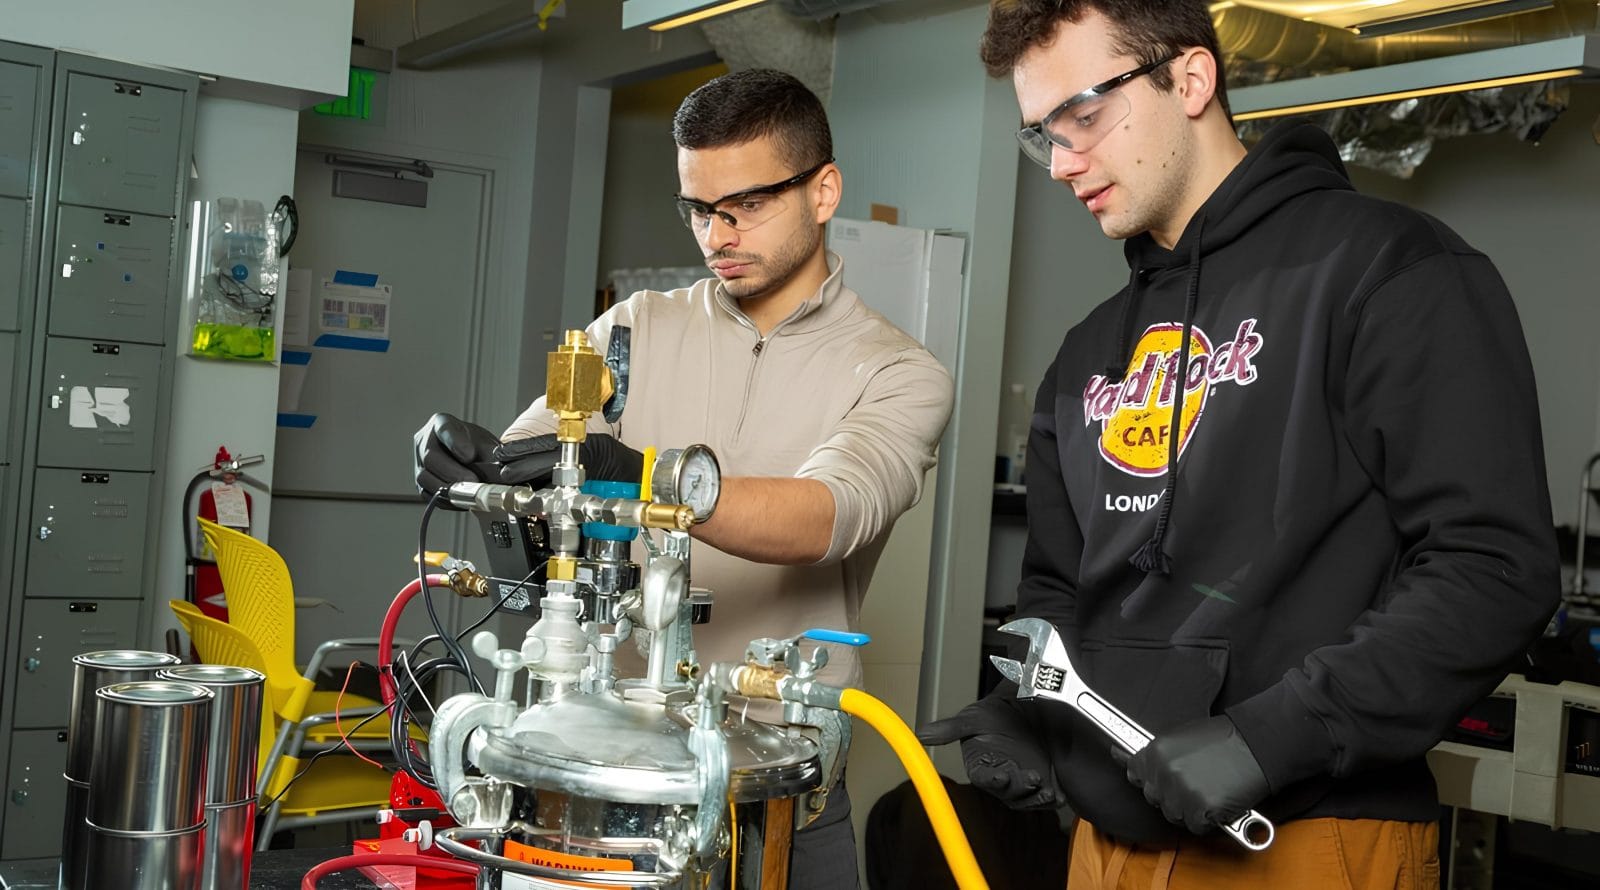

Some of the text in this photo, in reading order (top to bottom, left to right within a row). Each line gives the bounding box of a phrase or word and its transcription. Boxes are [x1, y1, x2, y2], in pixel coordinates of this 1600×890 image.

[1083, 352, 1160, 427] Had
[1122, 425, 1169, 447] CAF
[1105, 488, 1166, 512] LOND
